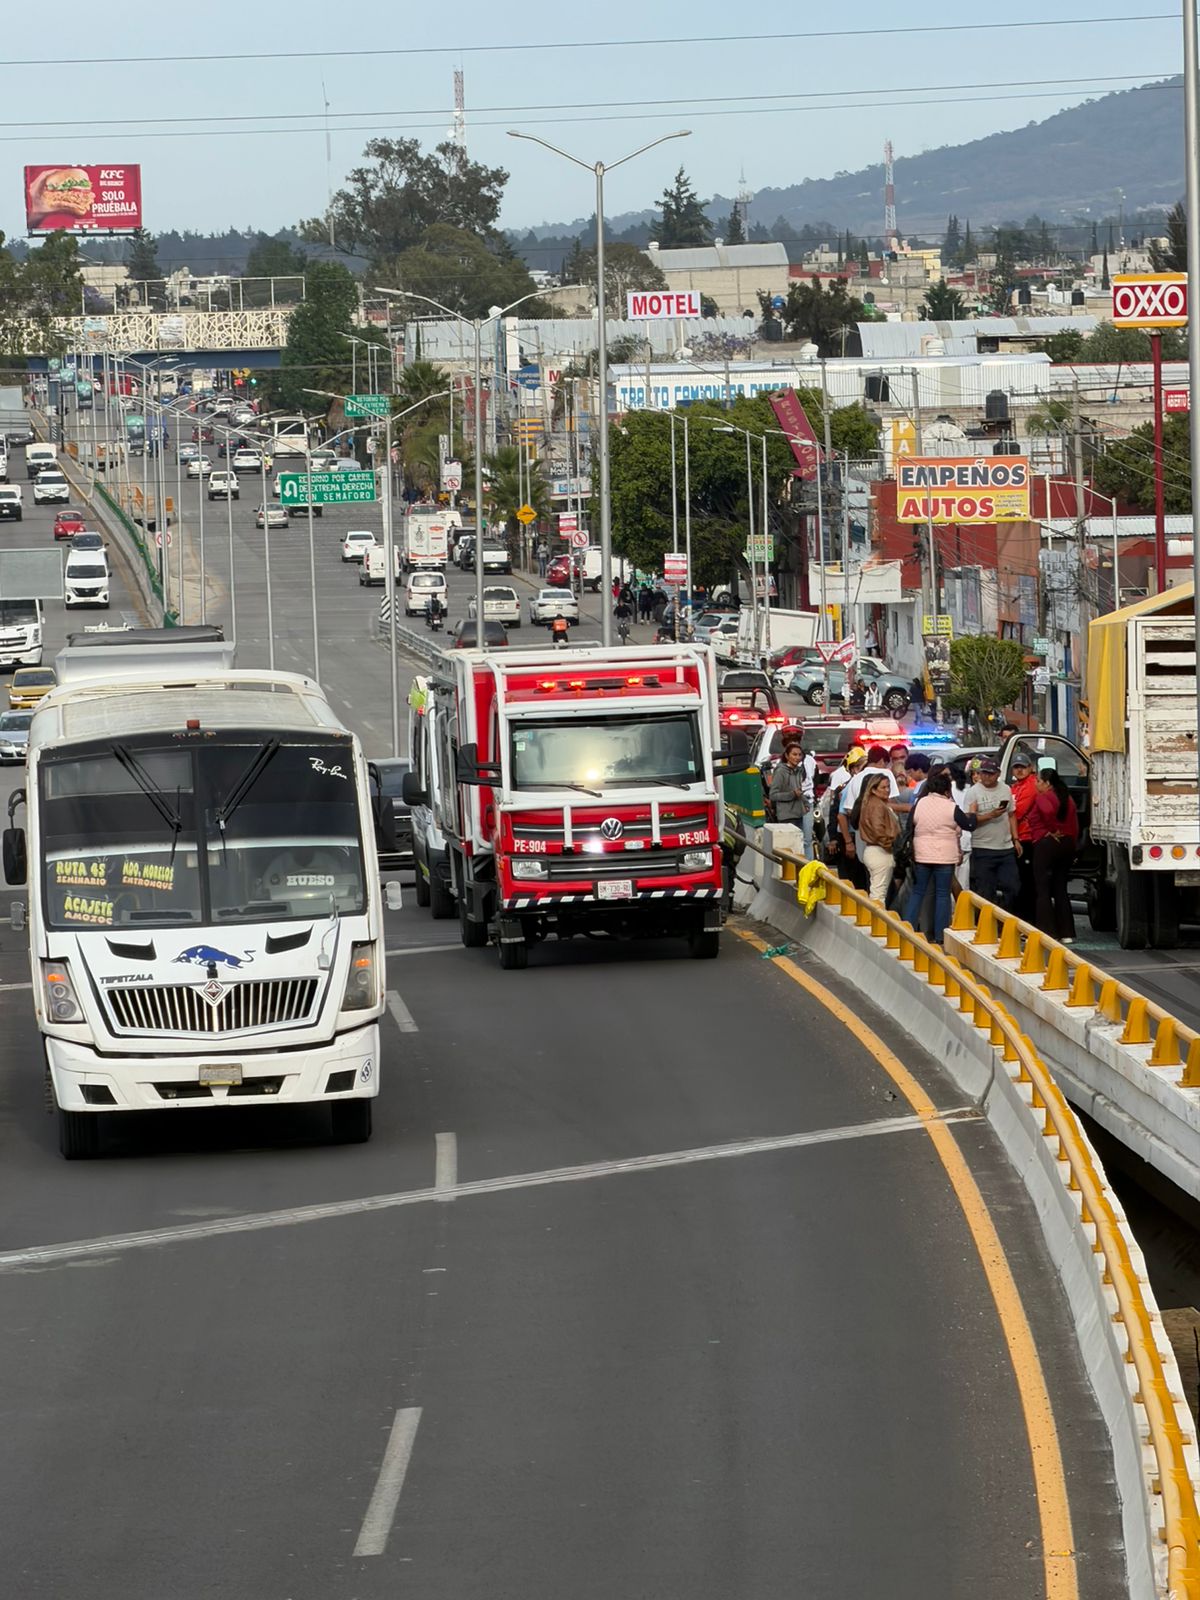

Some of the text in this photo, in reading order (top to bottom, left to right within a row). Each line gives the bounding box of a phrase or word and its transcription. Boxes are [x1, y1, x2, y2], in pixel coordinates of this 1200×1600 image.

[100, 170, 124, 179] KFC
[102, 191, 125, 201] SOLO
[92, 202, 137, 213] PRUÉBALA
[632, 294, 698, 315] MOTEL
[1115, 284, 1185, 318] OXXO
[620, 386, 670, 408] TRATO
[298, 473, 373, 483] REORNO POR CARRIL
[901, 458, 1026, 487] EMPEÑOS
[299, 482, 374, 493] DE EXTREMA DERECHA
[323, 491, 371, 500] SEMAFORO
[901, 496, 995, 518] AUTOS
[309, 757, 347, 779] Ray-Ban
[679, 831, 710, 846] PE-904
[514, 839, 546, 853] PE-904
[56, 861, 87, 876] RUTA
[56, 875, 107, 886] SEMINARIO
[122, 878, 174, 890] ENTRONQUE
[286, 875, 335, 886] HUESO
[64, 896, 114, 917] ACAJETE
[64, 911, 113, 925] AMOZOC
[99, 974, 154, 985] TEPETZALA
